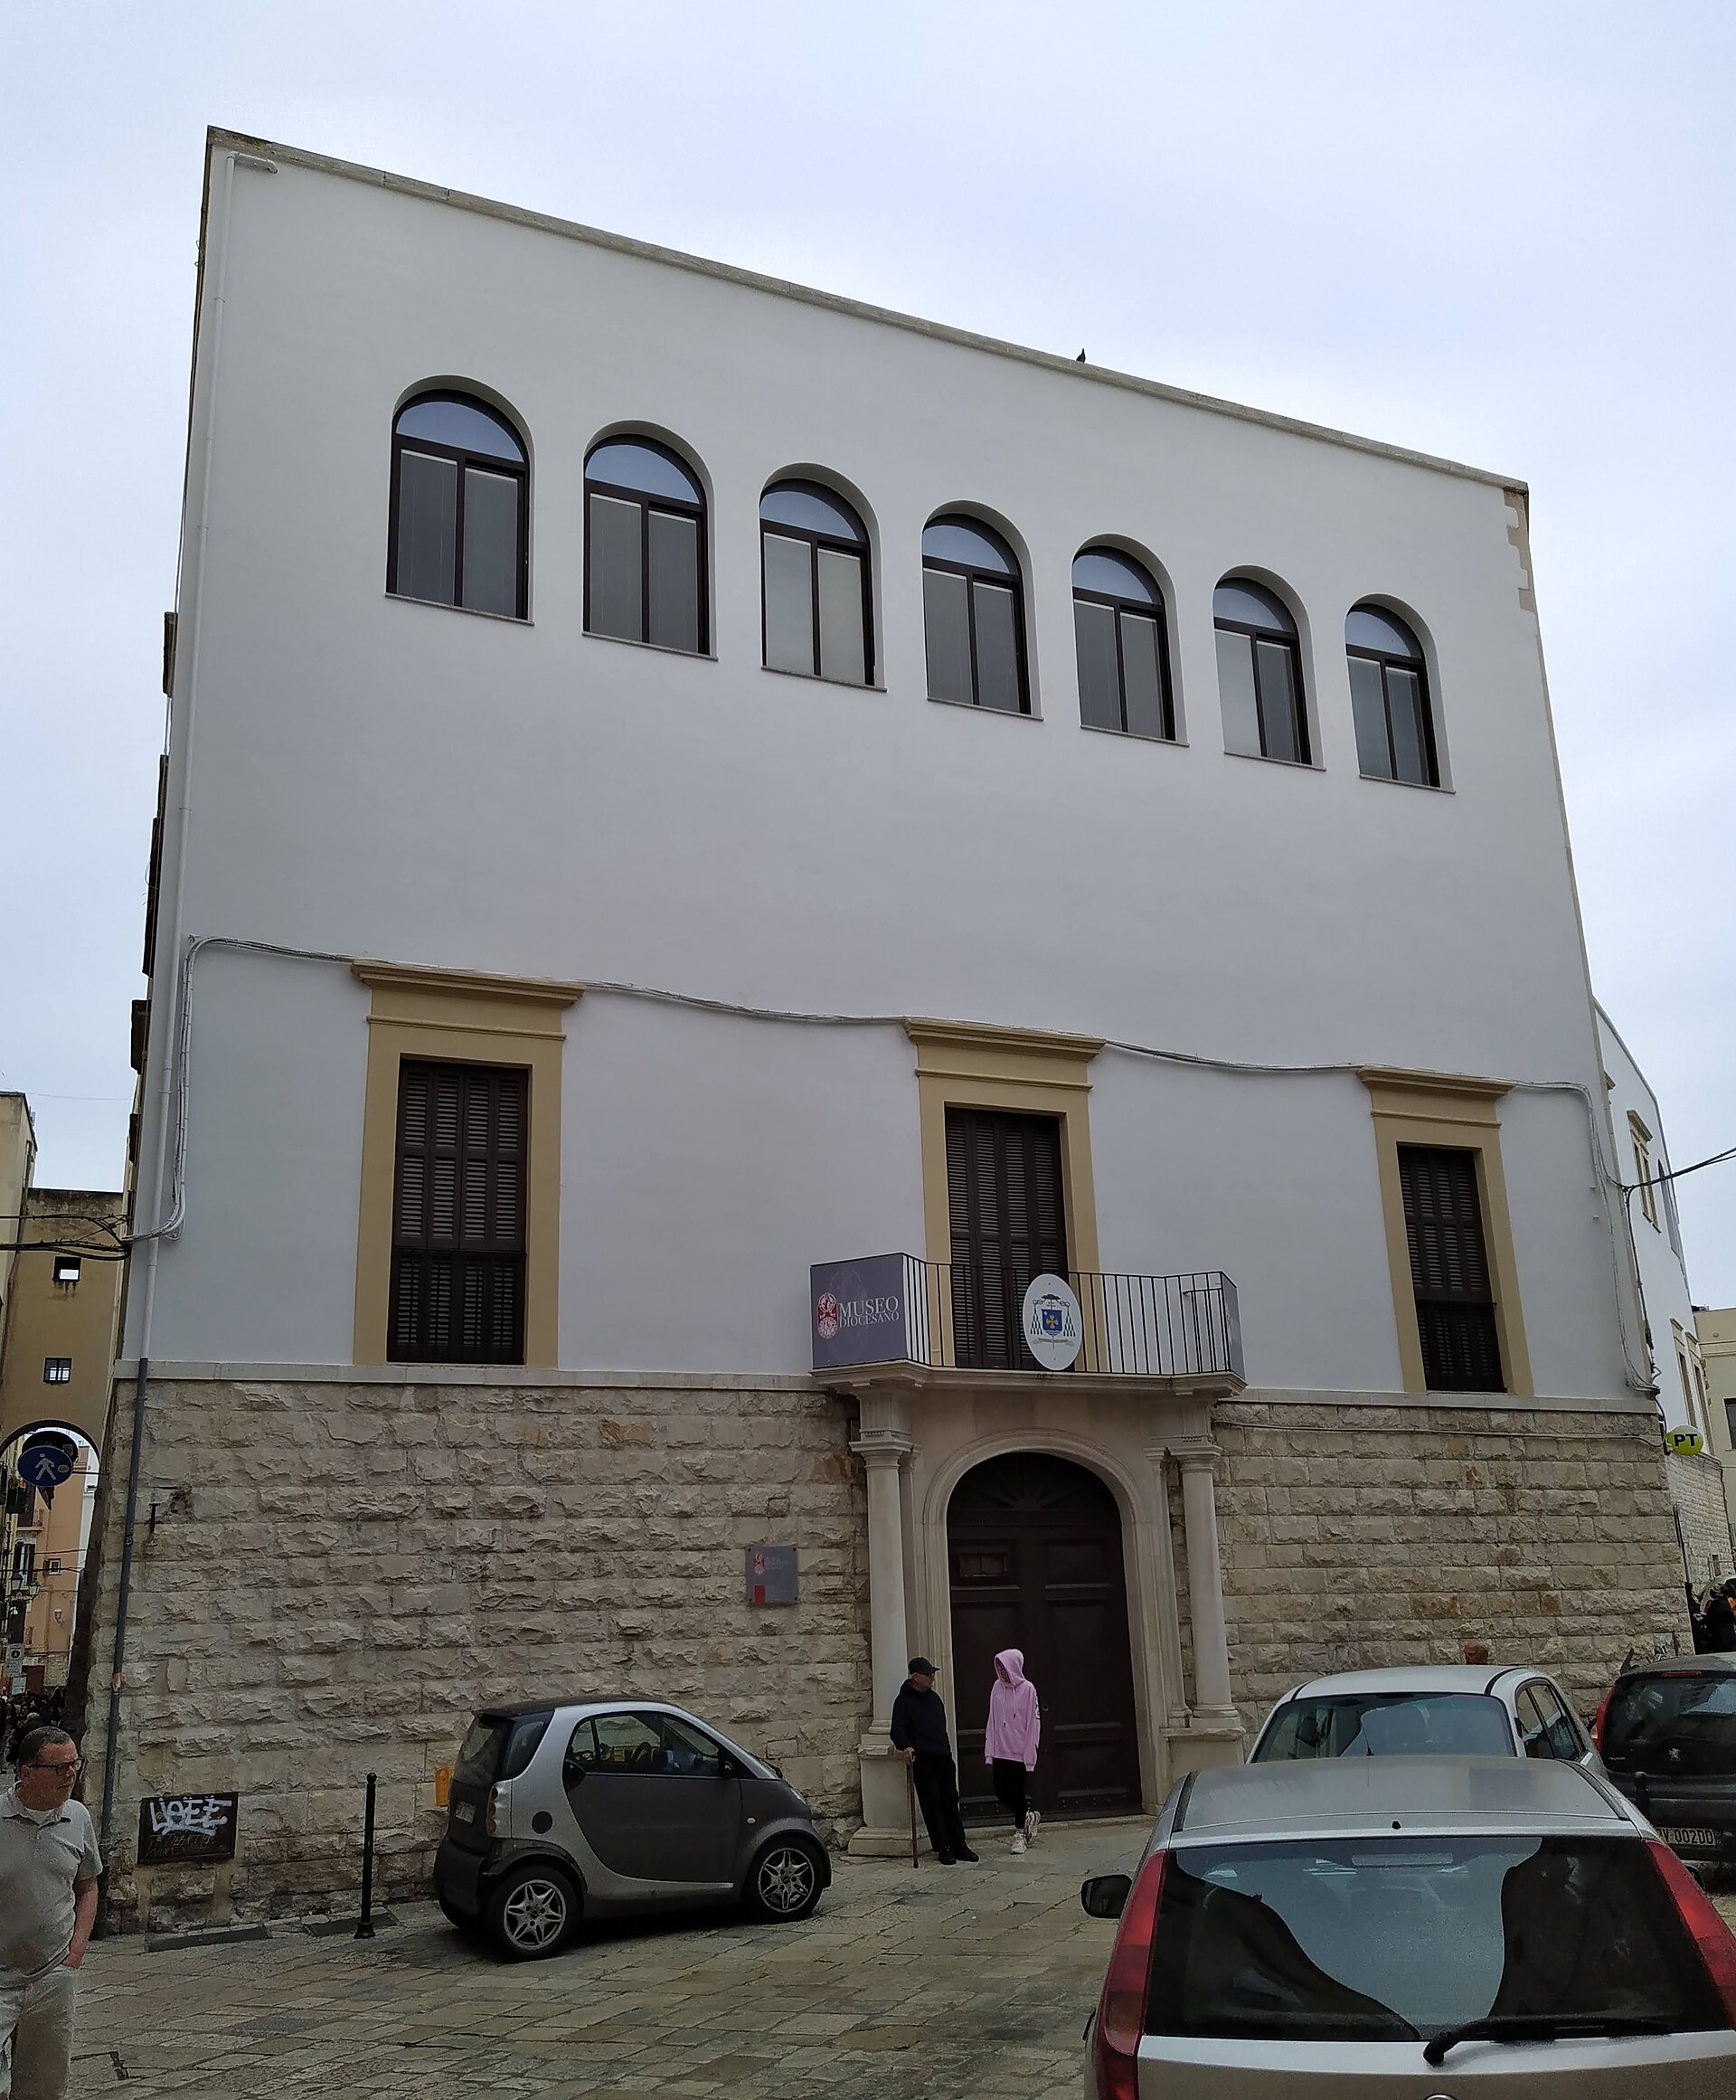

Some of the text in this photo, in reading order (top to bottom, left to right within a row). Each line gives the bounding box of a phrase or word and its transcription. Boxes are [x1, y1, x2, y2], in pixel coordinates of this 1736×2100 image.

[839, 1295, 899, 1319] MUSEO
[839, 1310, 900, 1329] DIOCESANO
[1674, 1433, 1698, 1447] PT
